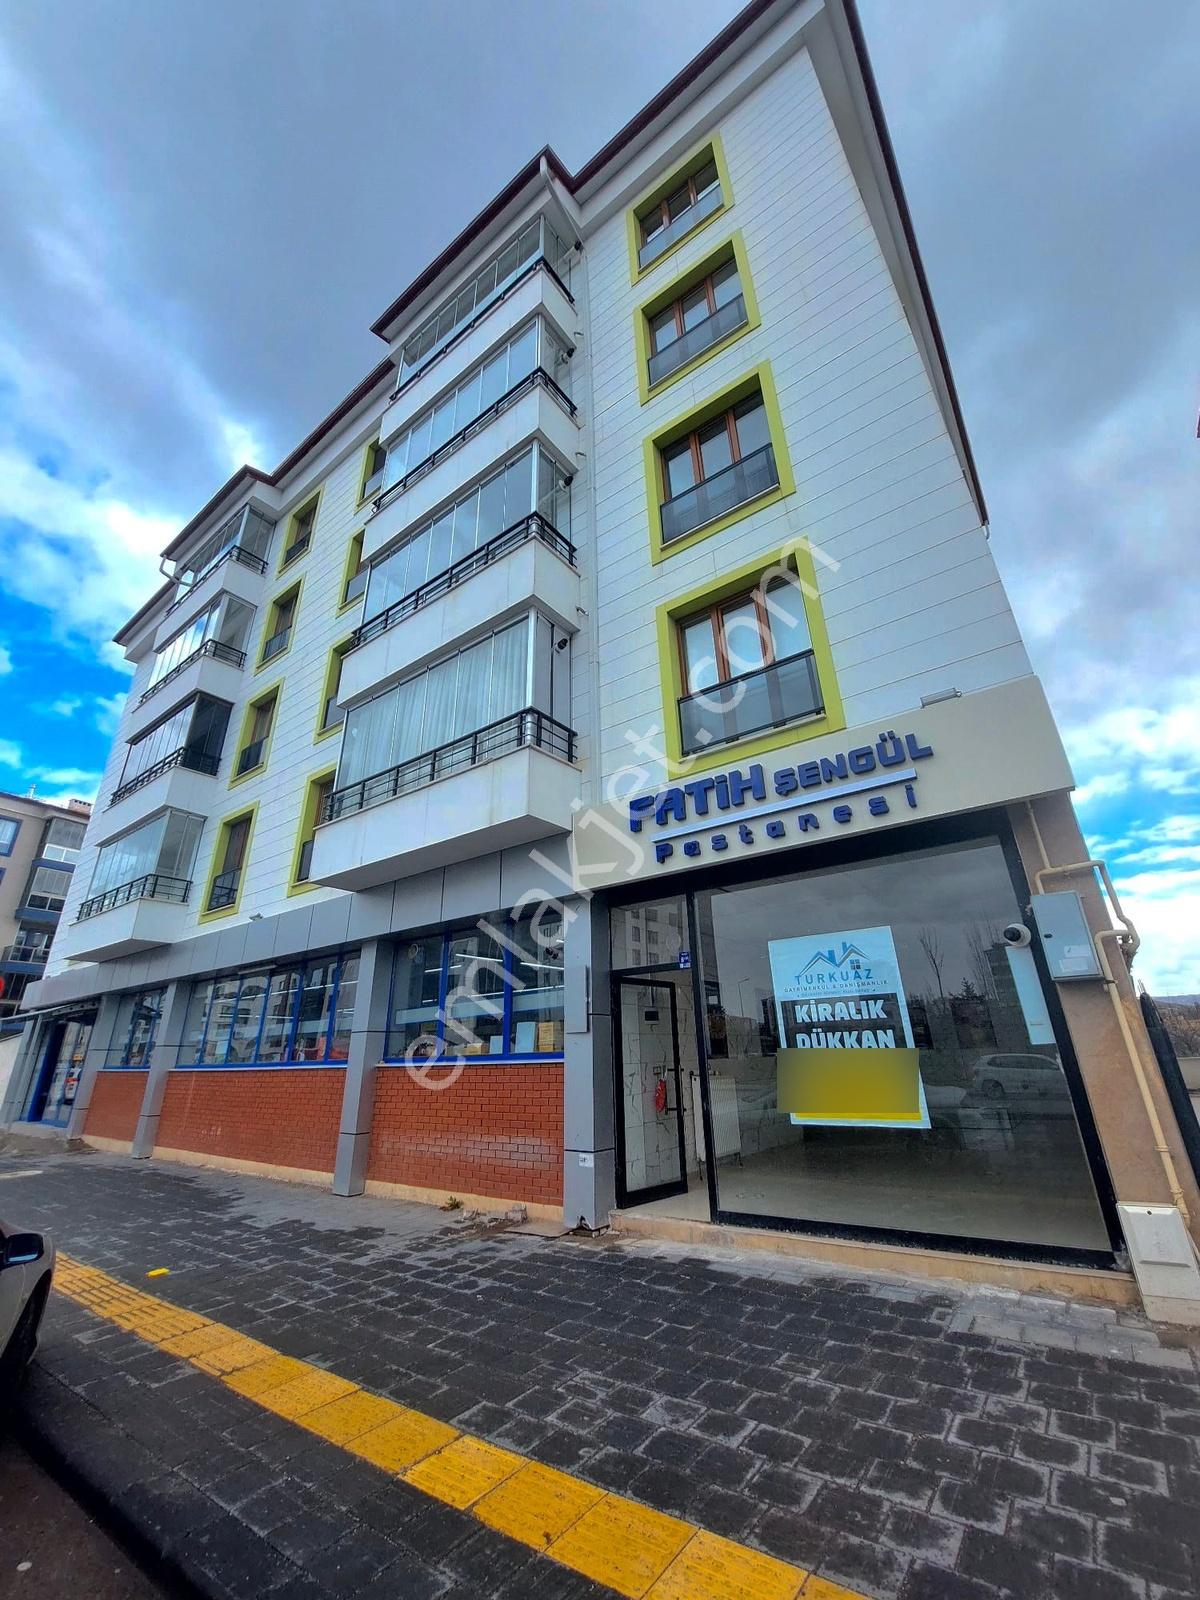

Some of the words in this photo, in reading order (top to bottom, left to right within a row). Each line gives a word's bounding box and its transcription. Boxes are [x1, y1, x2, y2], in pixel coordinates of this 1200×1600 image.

[773, 730, 934, 796] ŞENGÜL
[795, 999, 888, 1023] KİRALIK
[796, 1029, 896, 1048] DÜKKAN
